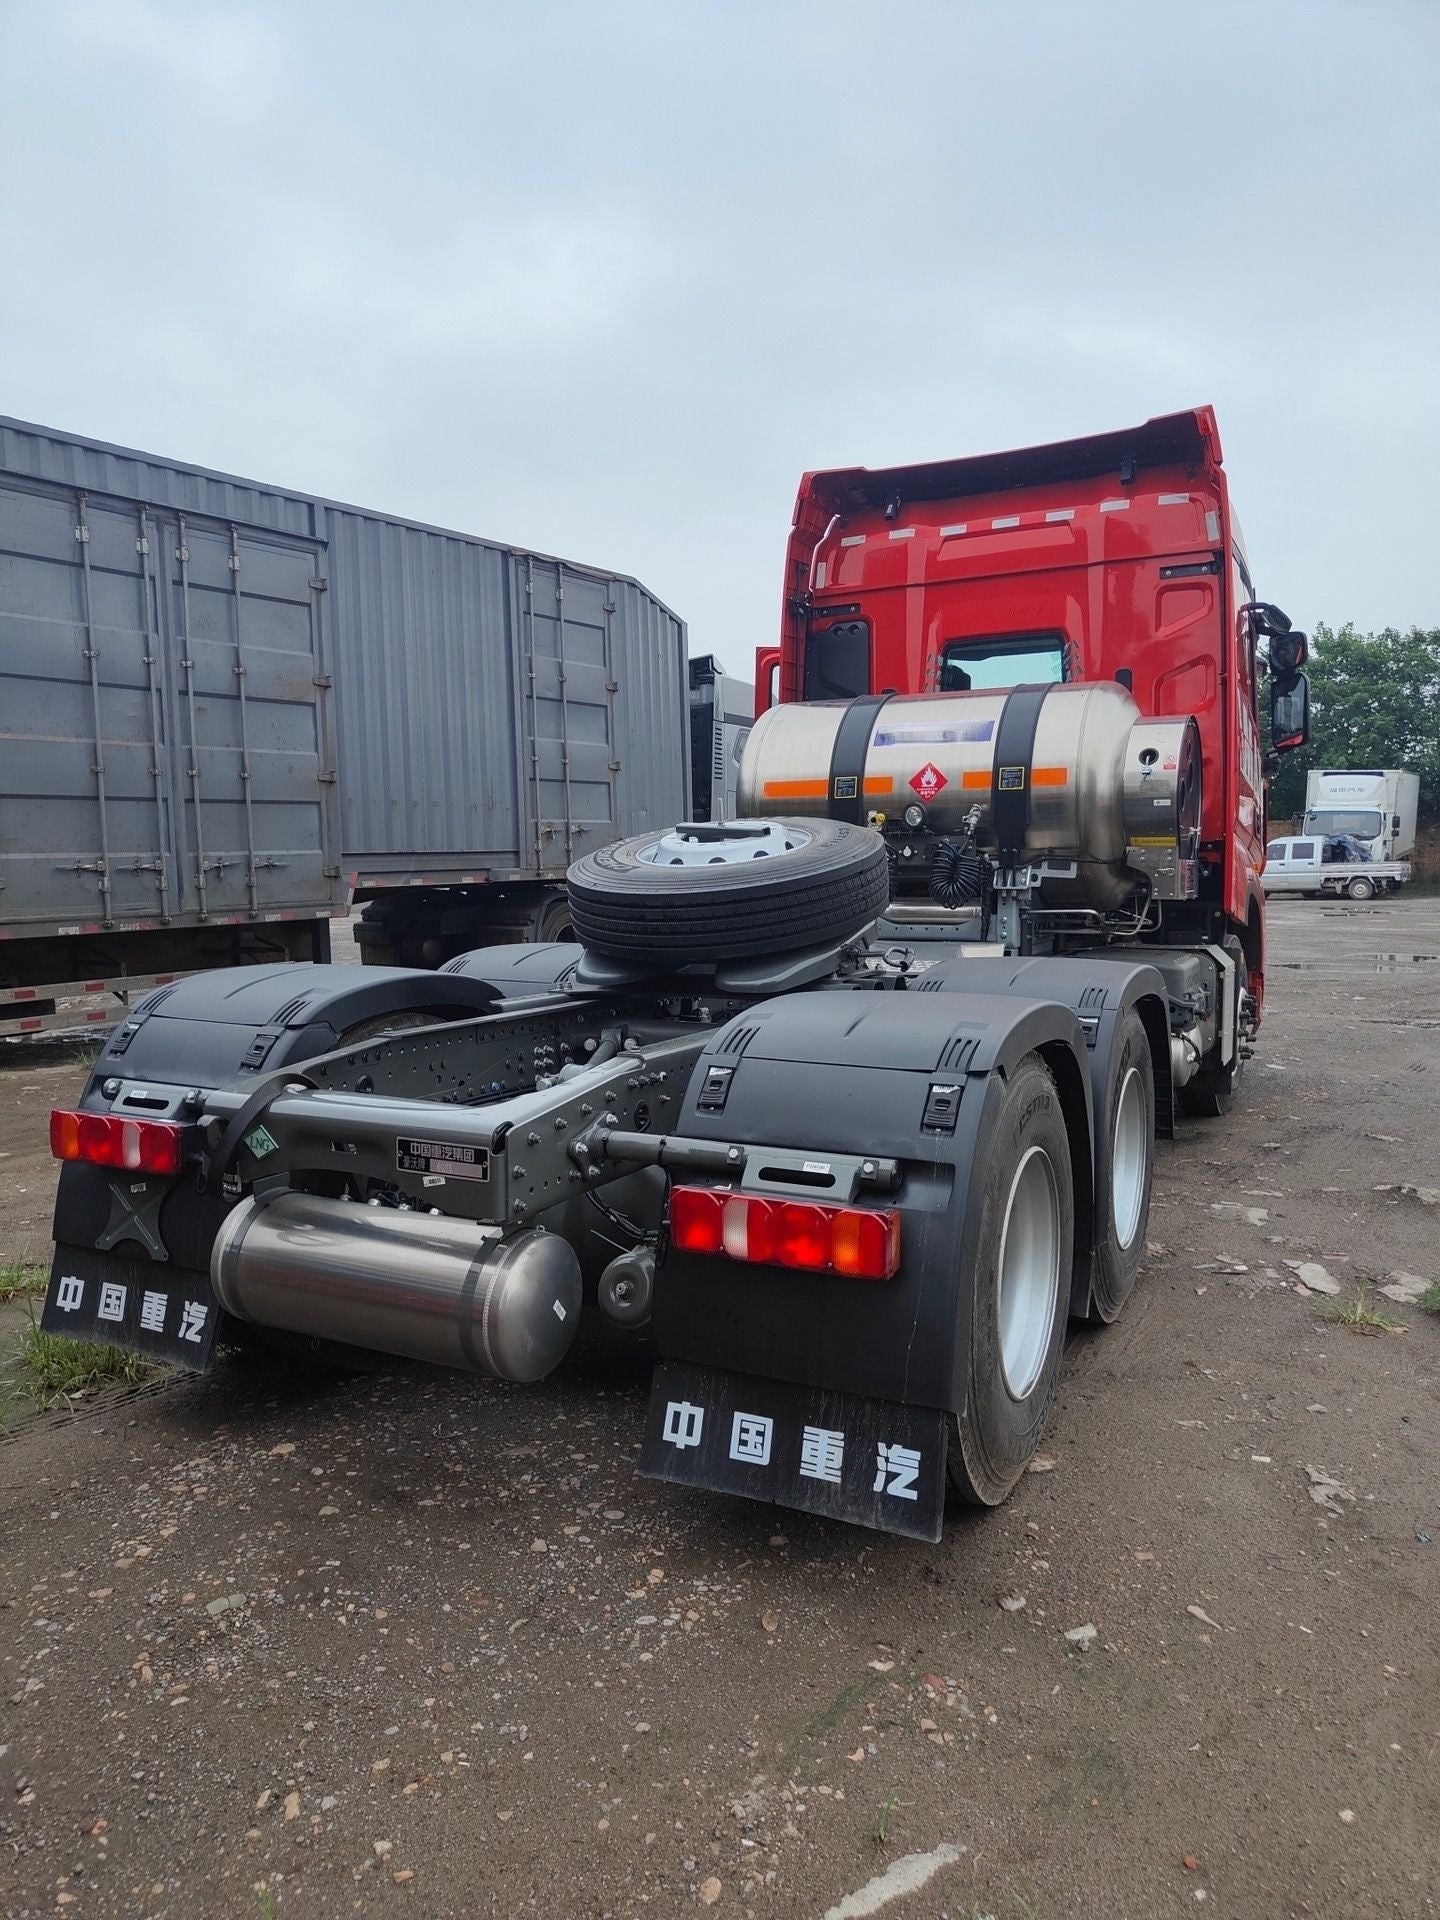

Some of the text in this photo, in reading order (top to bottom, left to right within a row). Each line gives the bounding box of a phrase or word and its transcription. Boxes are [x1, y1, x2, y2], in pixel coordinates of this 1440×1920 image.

[250, 1135, 270, 1151] LNG
[410, 1142, 474, 1163] 中国重汽集团
[56, 1276, 208, 1343] 中国重汽
[662, 1401, 921, 1501] 中国重汽
